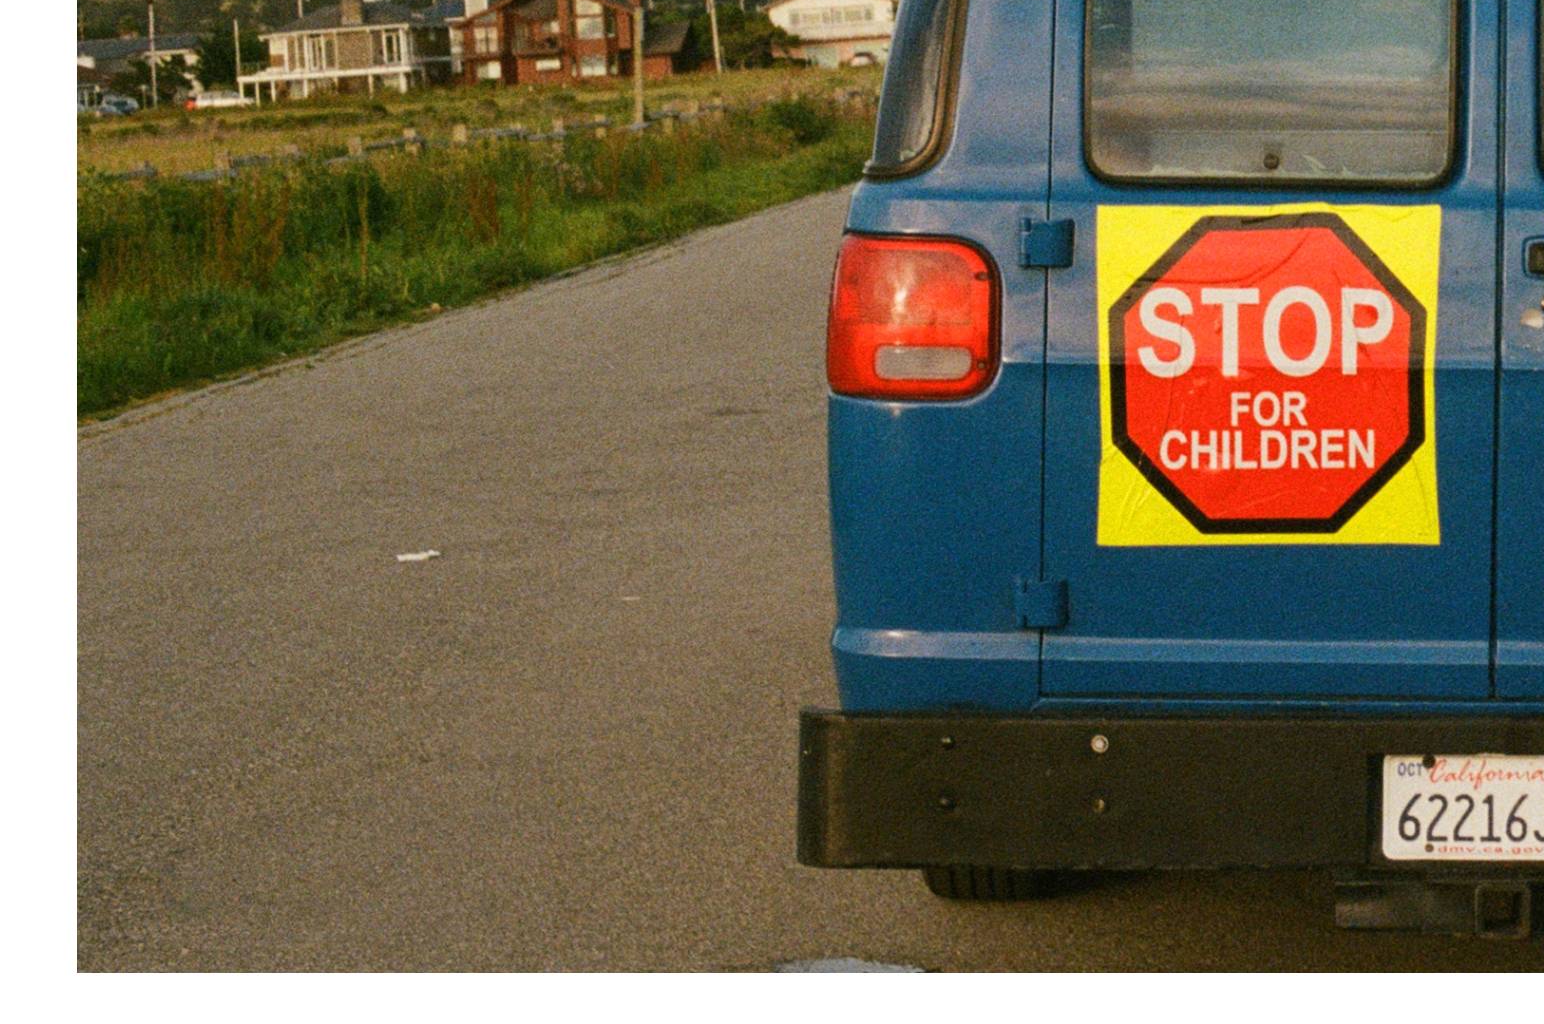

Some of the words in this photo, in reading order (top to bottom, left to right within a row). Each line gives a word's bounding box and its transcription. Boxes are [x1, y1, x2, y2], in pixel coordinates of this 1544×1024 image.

[1137, 285, 1395, 378] STOP
[1230, 391, 1308, 427] FOR
[1159, 429, 1376, 471] CHILDREN
[1397, 761, 1424, 777] OCT
